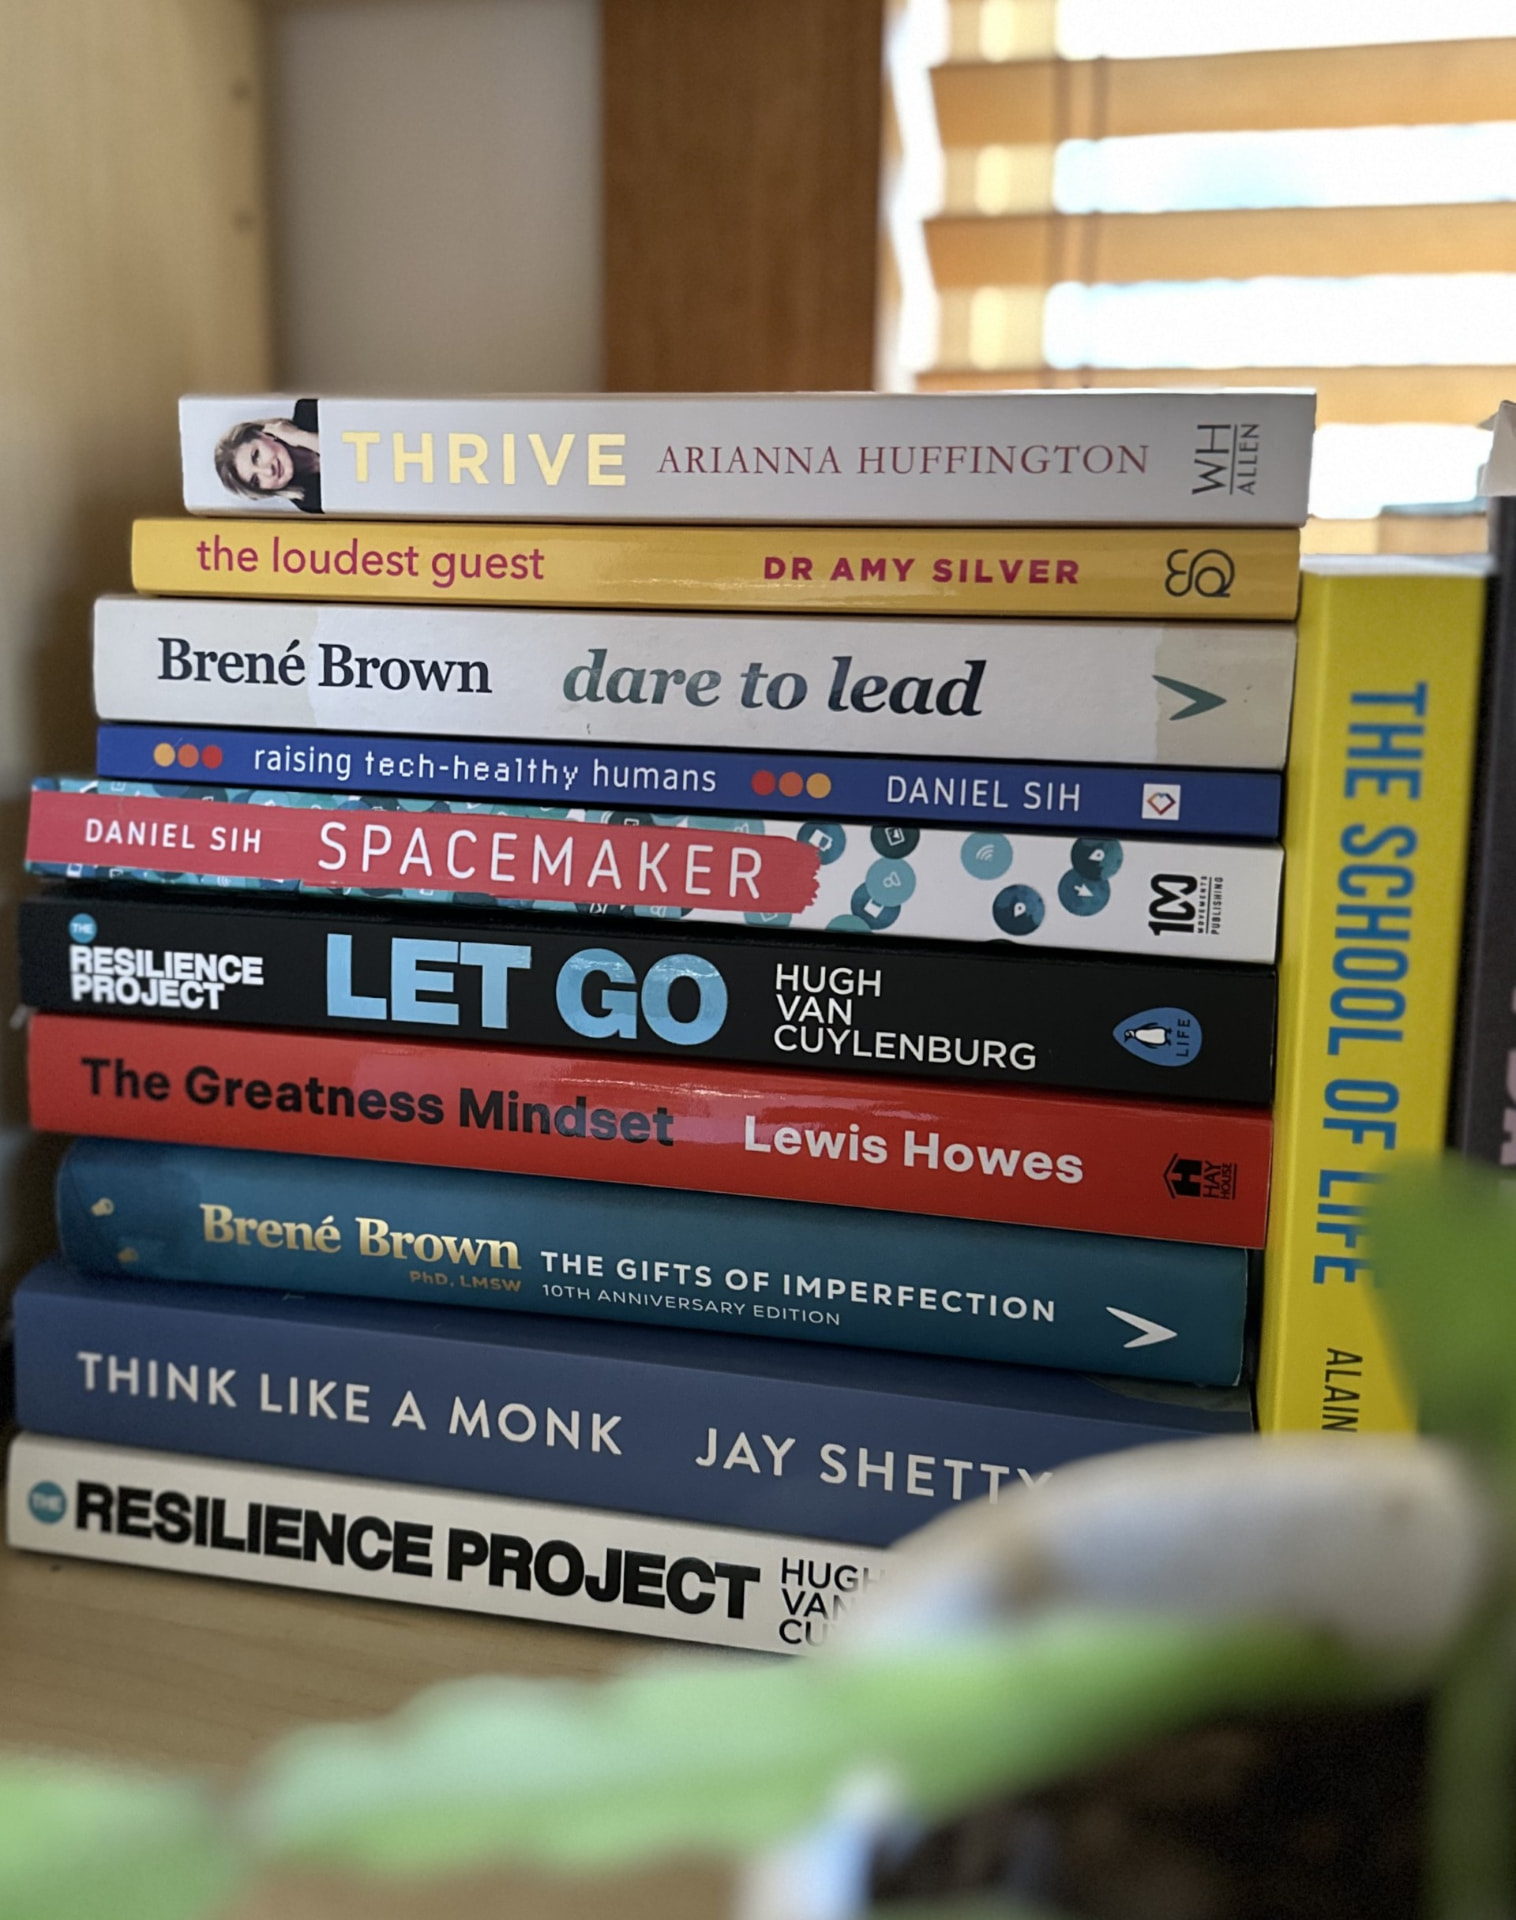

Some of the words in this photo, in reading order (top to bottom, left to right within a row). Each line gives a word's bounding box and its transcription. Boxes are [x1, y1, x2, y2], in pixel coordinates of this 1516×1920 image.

[342, 431, 627, 487] THRIVE
[655, 444, 841, 475] ARIANNA
[857, 443, 1150, 475] HUFFINGTON
[1191, 424, 1231, 495] WH
[1236, 423, 1260, 496] ALLEN
[196, 534, 259, 573] the
[272, 536, 420, 577] loudest
[431, 548, 545, 589] guest
[763, 557, 813, 580] DR
[830, 557, 915, 582] AMY
[932, 558, 1079, 585] SILVER
[157, 637, 306, 686] Brené
[318, 643, 493, 695] Brown
[562, 648, 720, 708] dare
[740, 662, 808, 711] to
[827, 656, 987, 718] lead
[1343, 680, 1428, 800] THE
[253, 745, 352, 780] raising
[365, 750, 579, 788] tech-healthy
[592, 761, 717, 792] humans
[886, 775, 1008, 808] DANIEL
[1023, 780, 1081, 812] SIH
[84, 818, 196, 850] DANIEL
[210, 826, 262, 853] SIH
[317, 821, 764, 900] SPACEMAKER
[72, 921, 94, 936] THE
[1211, 876, 1224, 935] PUBLISHING
[69, 944, 264, 986] RESILIENCE
[1326, 823, 1419, 1056] SCHOOL
[71, 974, 226, 1010] PROJECT
[326, 933, 532, 1029] LET
[555, 948, 729, 1047] GO
[774, 963, 882, 998] HUGH
[776, 993, 853, 1025] VAN
[773, 1025, 1037, 1071] CUYLENBURG
[1176, 1018, 1191, 1057] LIFE
[82, 1057, 170, 1101] The
[184, 1065, 444, 1126] Greatness
[459, 1087, 674, 1147] Mindset
[1322, 1079, 1401, 1152] OF
[744, 1115, 888, 1164] Lewis
[903, 1130, 1085, 1185] Howes
[1203, 1160, 1221, 1199] HAY
[1221, 1162, 1232, 1200] HOUSE
[200, 1202, 342, 1254] Brené
[355, 1216, 522, 1270] Brown
[409, 1269, 455, 1288] PhD,
[459, 1274, 522, 1293] LMSW
[541, 1250, 604, 1278] THE
[616, 1257, 712, 1288] GIFTS
[724, 1268, 770, 1293] OF
[783, 1273, 1055, 1323] IMPERFECTION
[542, 1283, 591, 1301] 10TH
[597, 1288, 746, 1317] ANNIVERSARY
[753, 1304, 841, 1327] EDITION
[77, 1351, 237, 1408] THINK
[260, 1372, 370, 1424] LIKE
[391, 1390, 427, 1431] A
[448, 1395, 622, 1456] MONK
[1321, 1347, 1364, 1434] ALAIN
[695, 1427, 795, 1477] JAY
[75, 1480, 434, 1578] RESILIENCE
[446, 1528, 761, 1621] PROJECT
